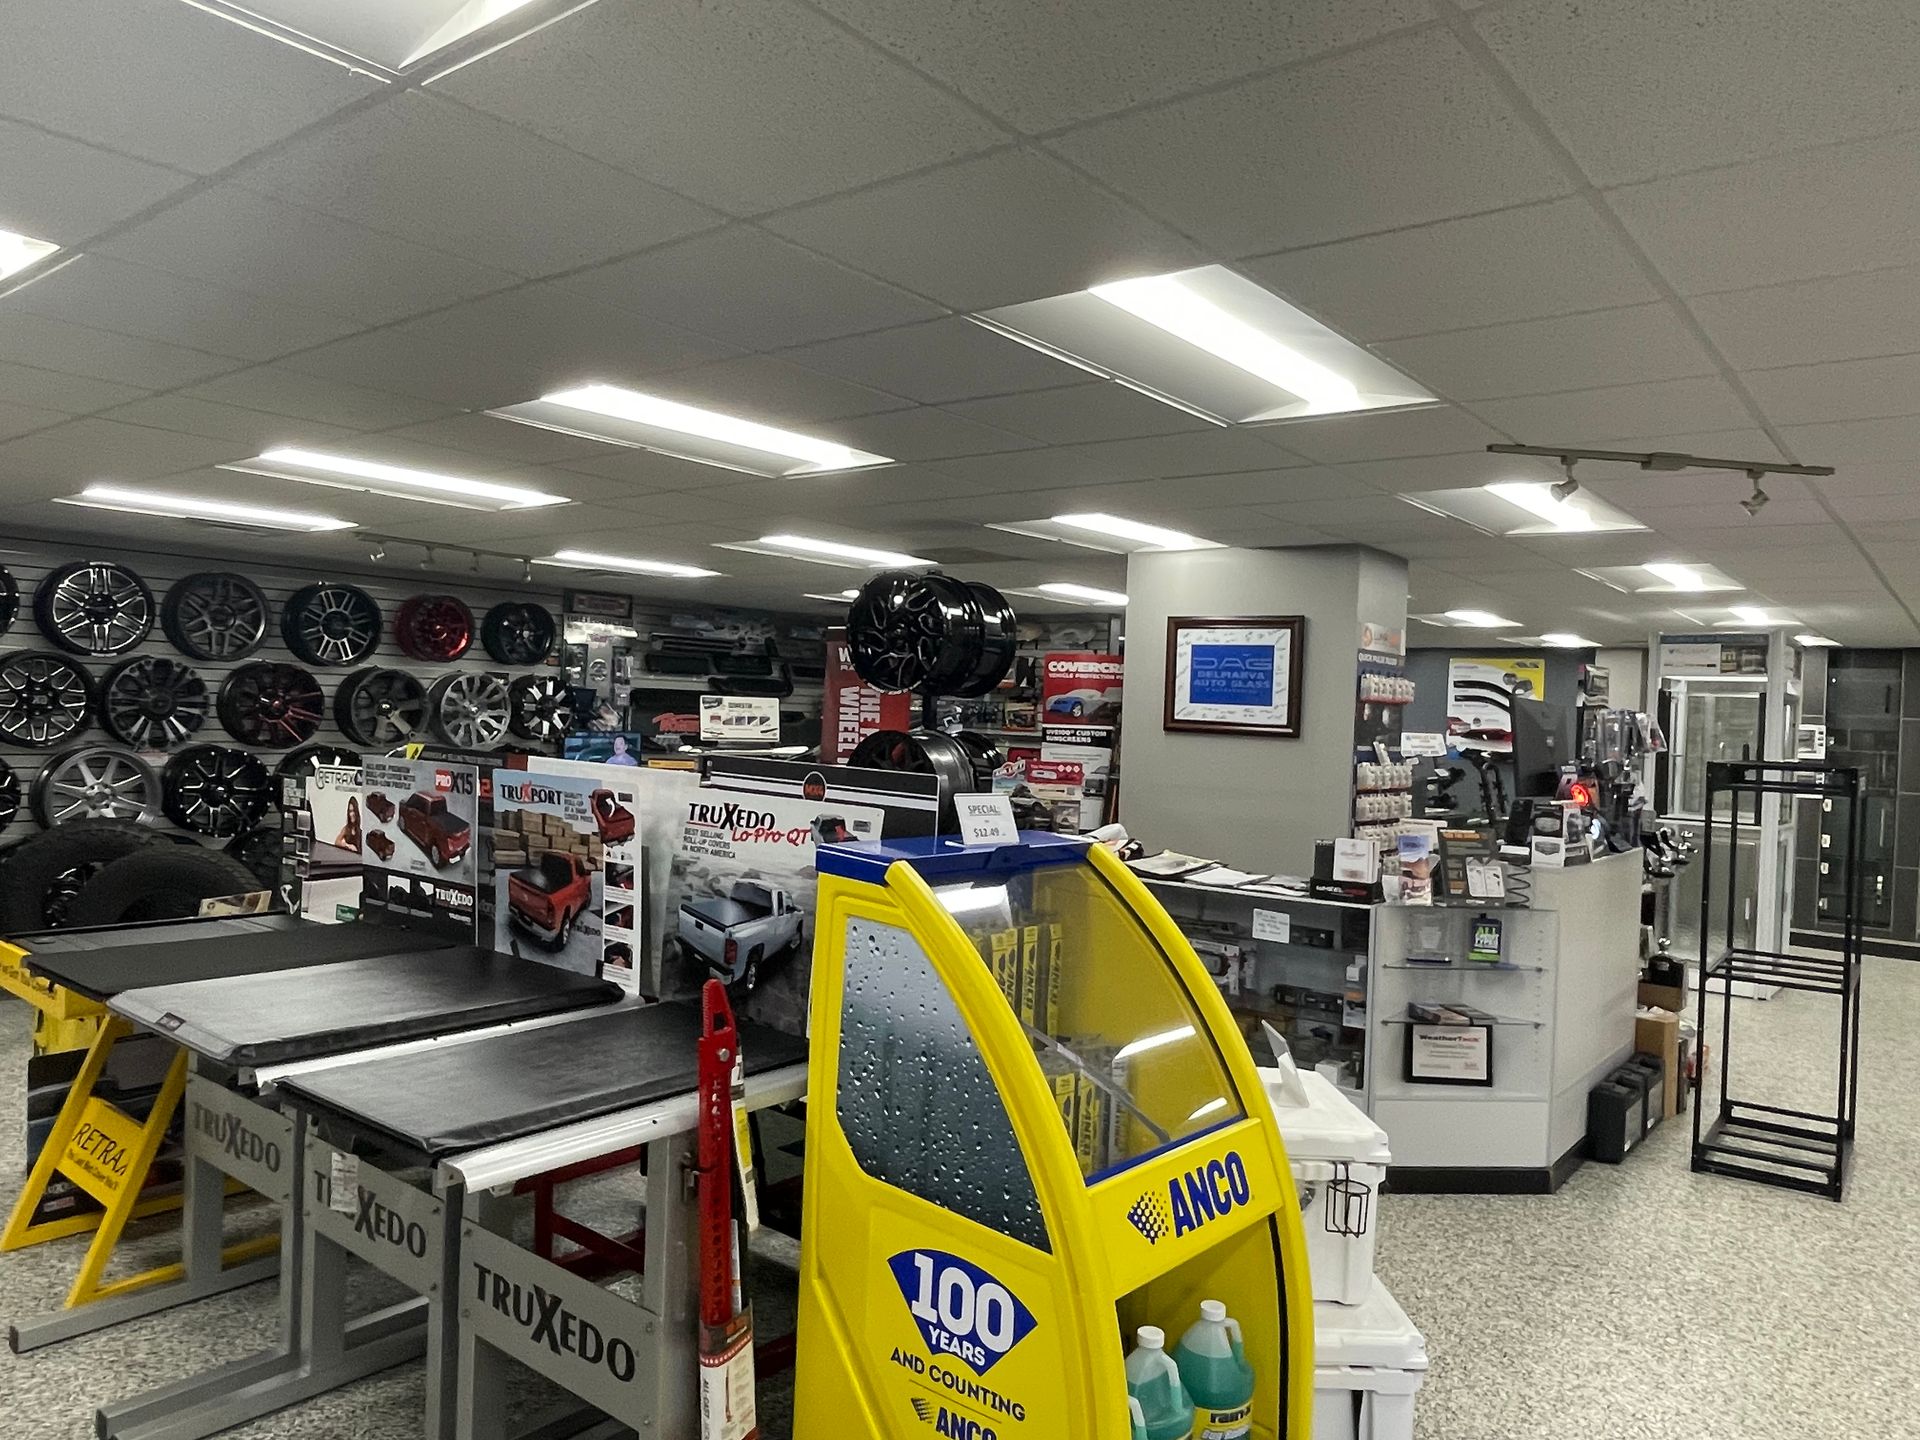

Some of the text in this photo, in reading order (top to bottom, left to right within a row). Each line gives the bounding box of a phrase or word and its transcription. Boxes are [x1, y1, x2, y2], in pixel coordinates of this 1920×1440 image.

[838, 685, 860, 753] WHEEL
[860, 688, 880, 723] THE
[689, 802, 775, 831] TRUXEDO
[435, 887, 473, 906] TRUXEDO
[193, 1101, 280, 1174] TRUXEDO
[314, 1169, 427, 1259] TXEDO
[1168, 1151, 1250, 1239] ANCO
[473, 1261, 636, 1383] TRUXEDO
[911, 1252, 1015, 1354] 100
[928, 1325, 986, 1367] YEARS
[890, 1346, 1027, 1423] AND COUNTING
